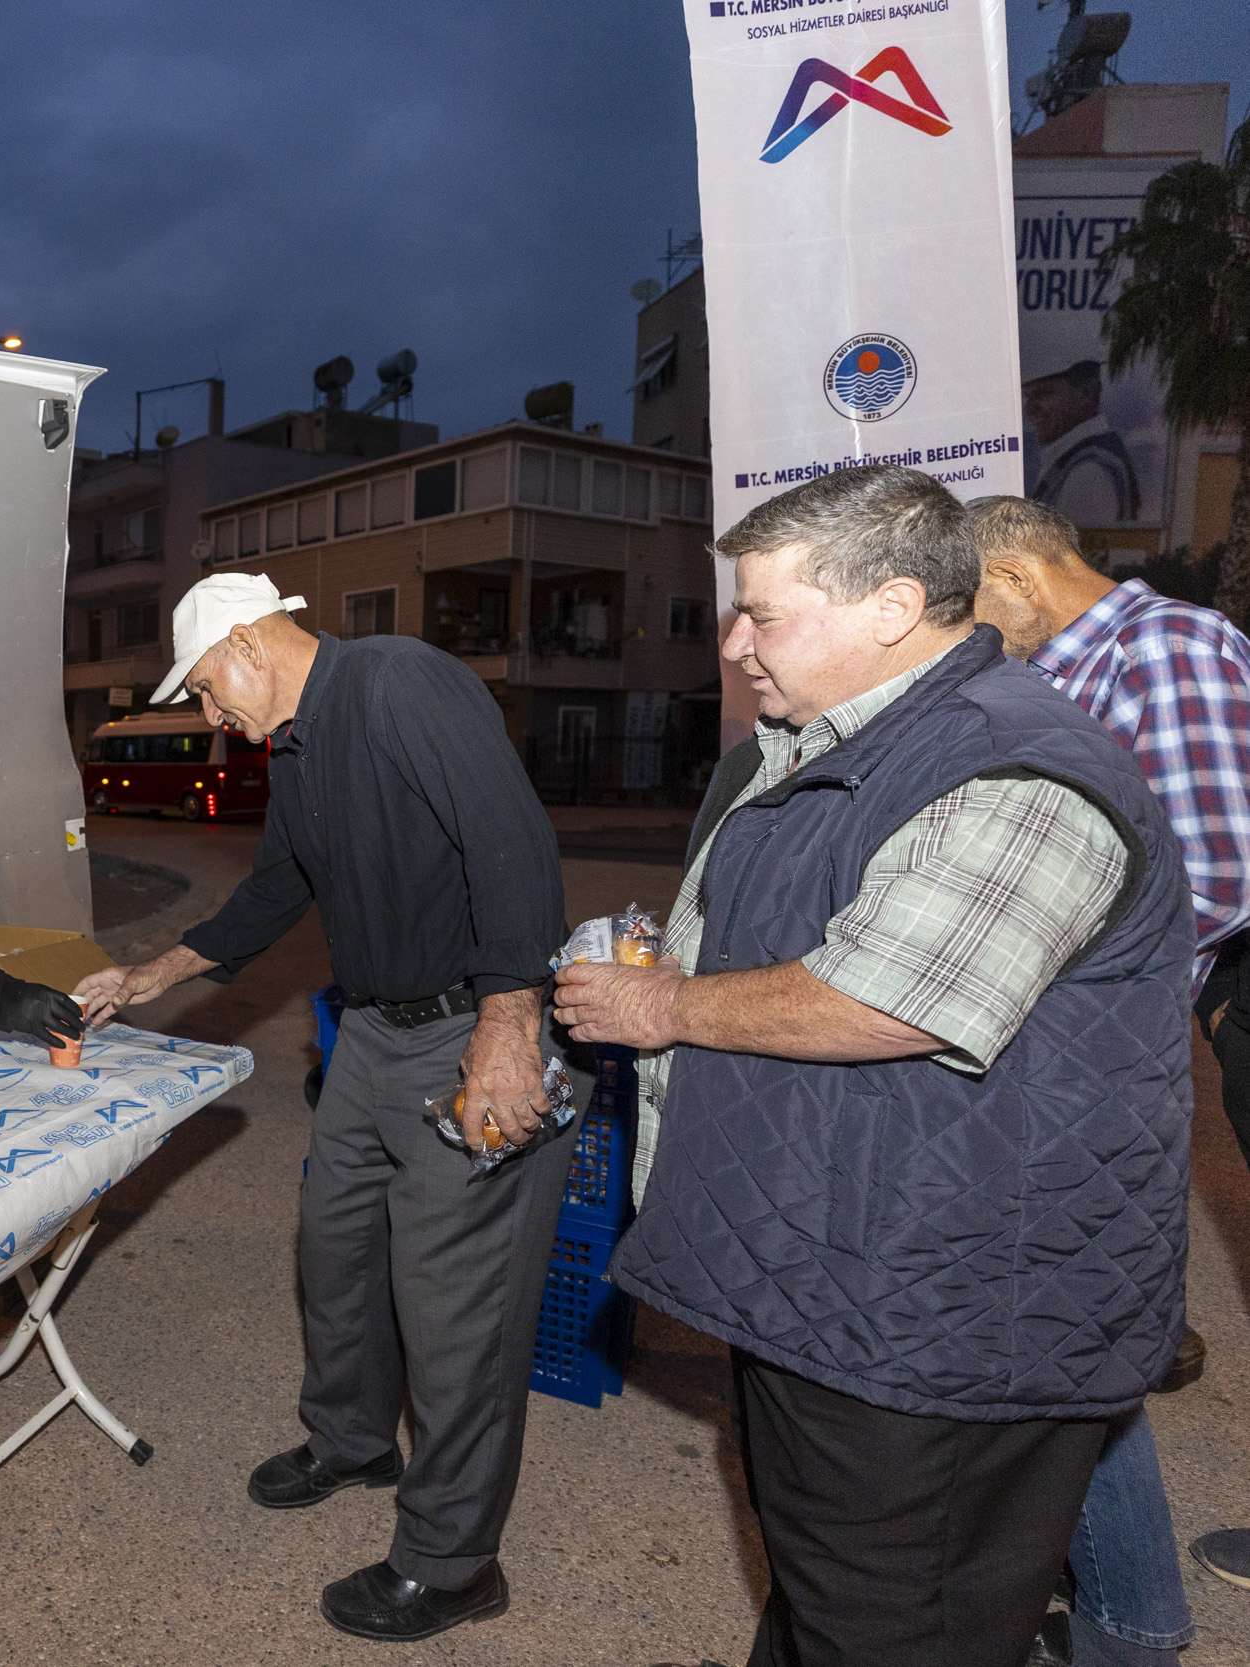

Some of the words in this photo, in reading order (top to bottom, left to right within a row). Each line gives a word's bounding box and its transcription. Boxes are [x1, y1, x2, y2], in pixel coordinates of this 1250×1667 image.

[747, 24, 787, 40] SOSYAL
[790, 16, 845, 35] HİZMETLER
[847, 6, 886, 25] DAİRESİ
[1017, 269, 1110, 310] ORUZ
[827, 359, 839, 391] MERSİN
[837, 336, 886, 359] BÜYÜKŞEHİR
[886, 339, 914, 379] BELEDİYESİ
[862, 411, 882, 420] 1873
[751, 472, 771, 487] T.C.
[774, 461, 829, 484] MERSİN
[927, 434, 1006, 463] BELEDİYESİ
